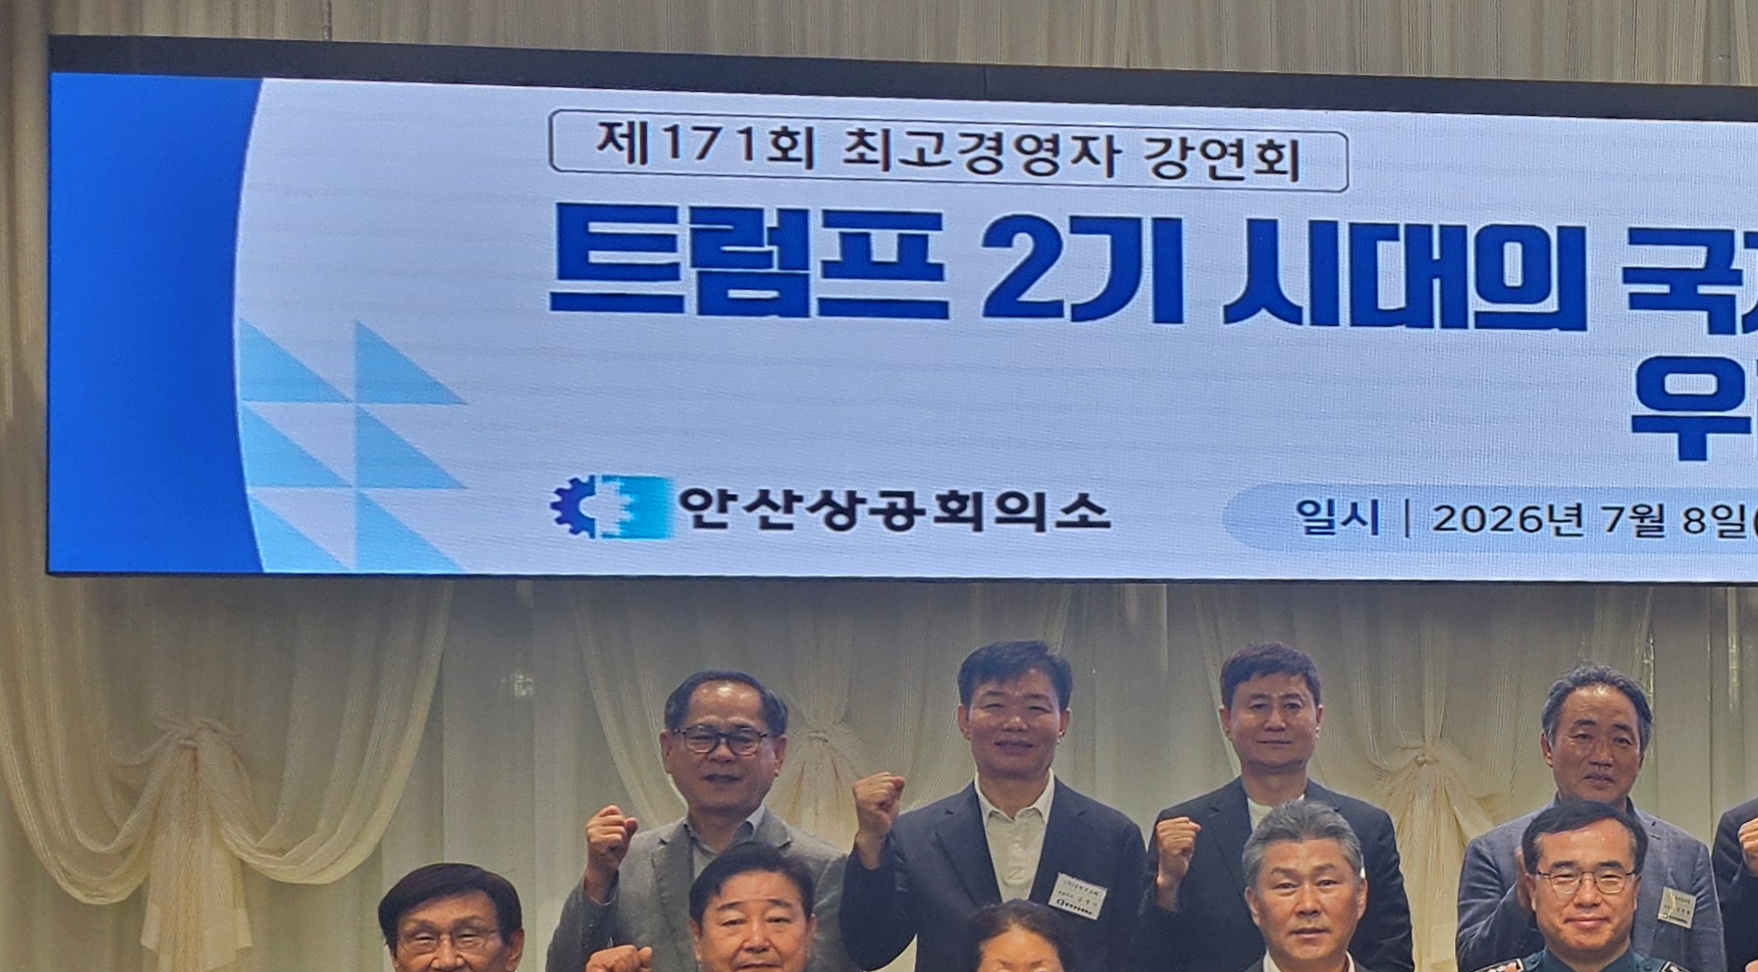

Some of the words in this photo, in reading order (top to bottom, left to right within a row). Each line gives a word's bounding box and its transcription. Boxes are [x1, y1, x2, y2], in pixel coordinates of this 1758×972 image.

[596, 119, 816, 171] 제171회
[842, 126, 1123, 180] 최고경영자
[1144, 136, 1300, 183] 강연회
[548, 201, 950, 321] 트럼프
[981, 213, 1185, 325] 2기
[1222, 217, 1588, 333] 시대의
[678, 487, 1112, 533] 안산상공회의소
[1296, 498, 1379, 536] 일시
[1432, 502, 1584, 538] 2026년
[1600, 503, 1666, 539] 7월
